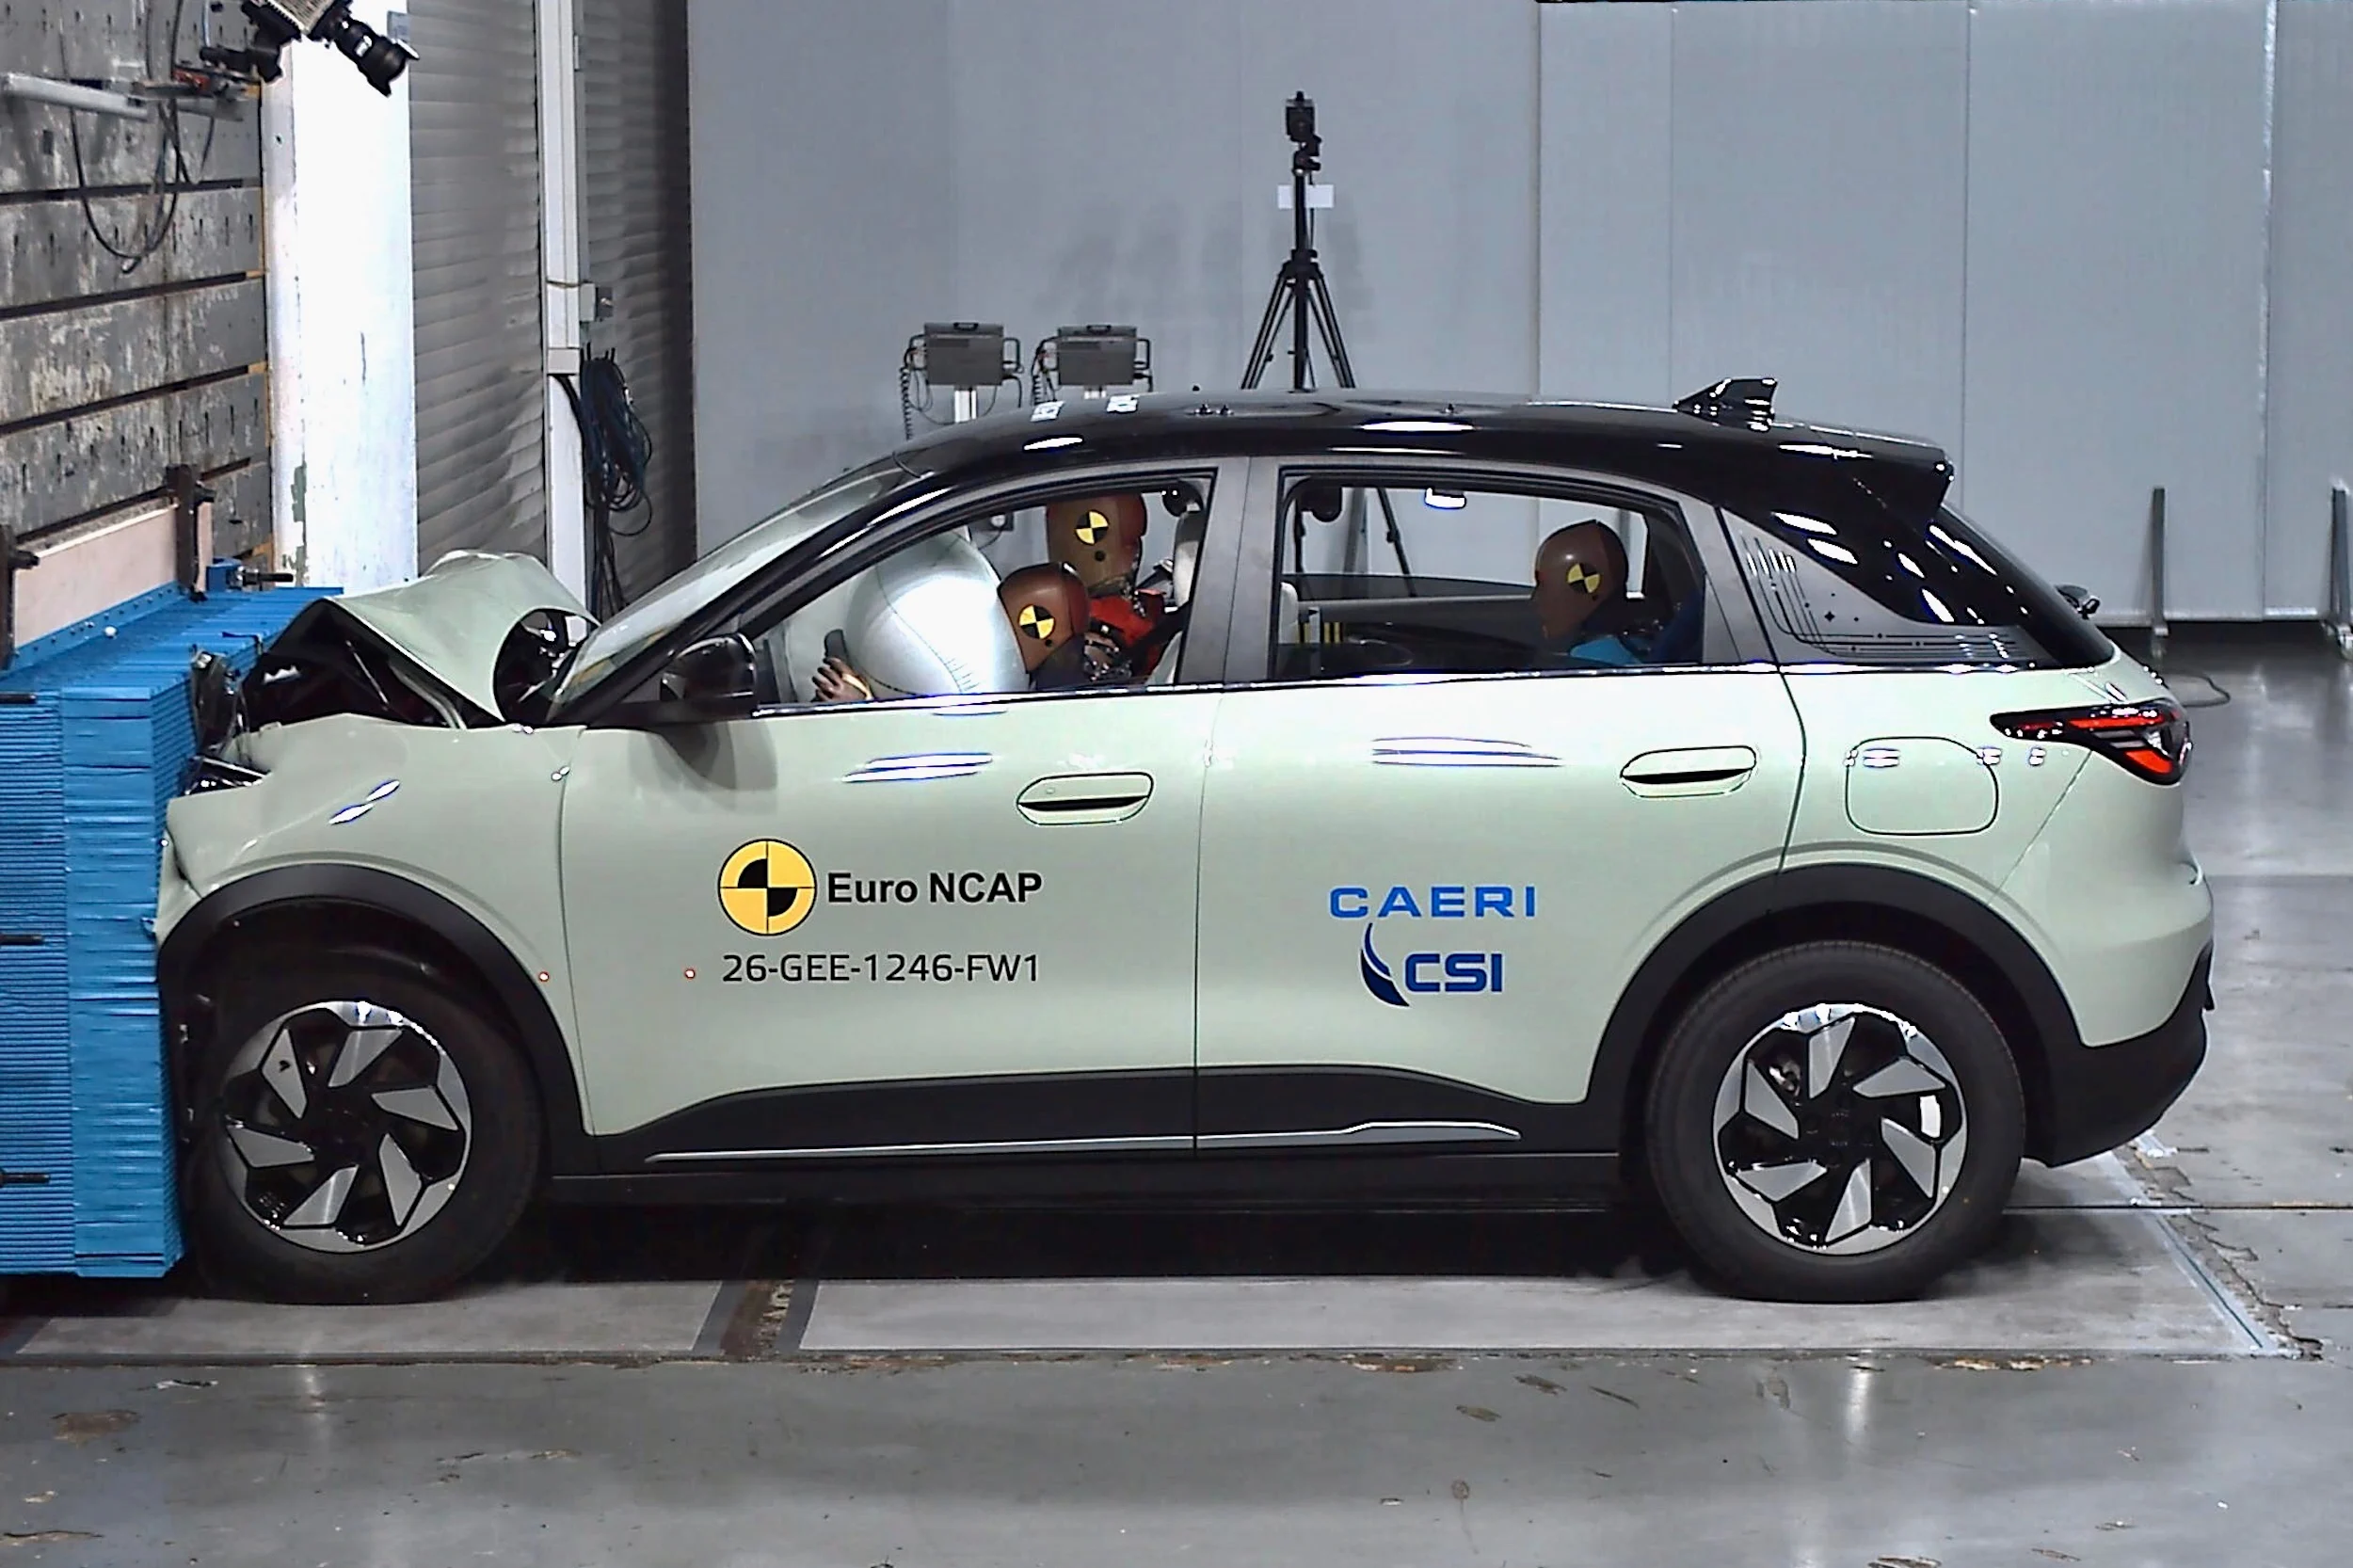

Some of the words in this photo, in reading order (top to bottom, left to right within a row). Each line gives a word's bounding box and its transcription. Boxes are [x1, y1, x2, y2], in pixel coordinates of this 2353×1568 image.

[827, 872, 919, 904] Euro
[930, 872, 1042, 904] NCAP
[1330, 886, 1535, 919] CAERI
[723, 953, 1037, 983] 26-GEE-1246-FW1
[1405, 953, 1503, 993] CSI
